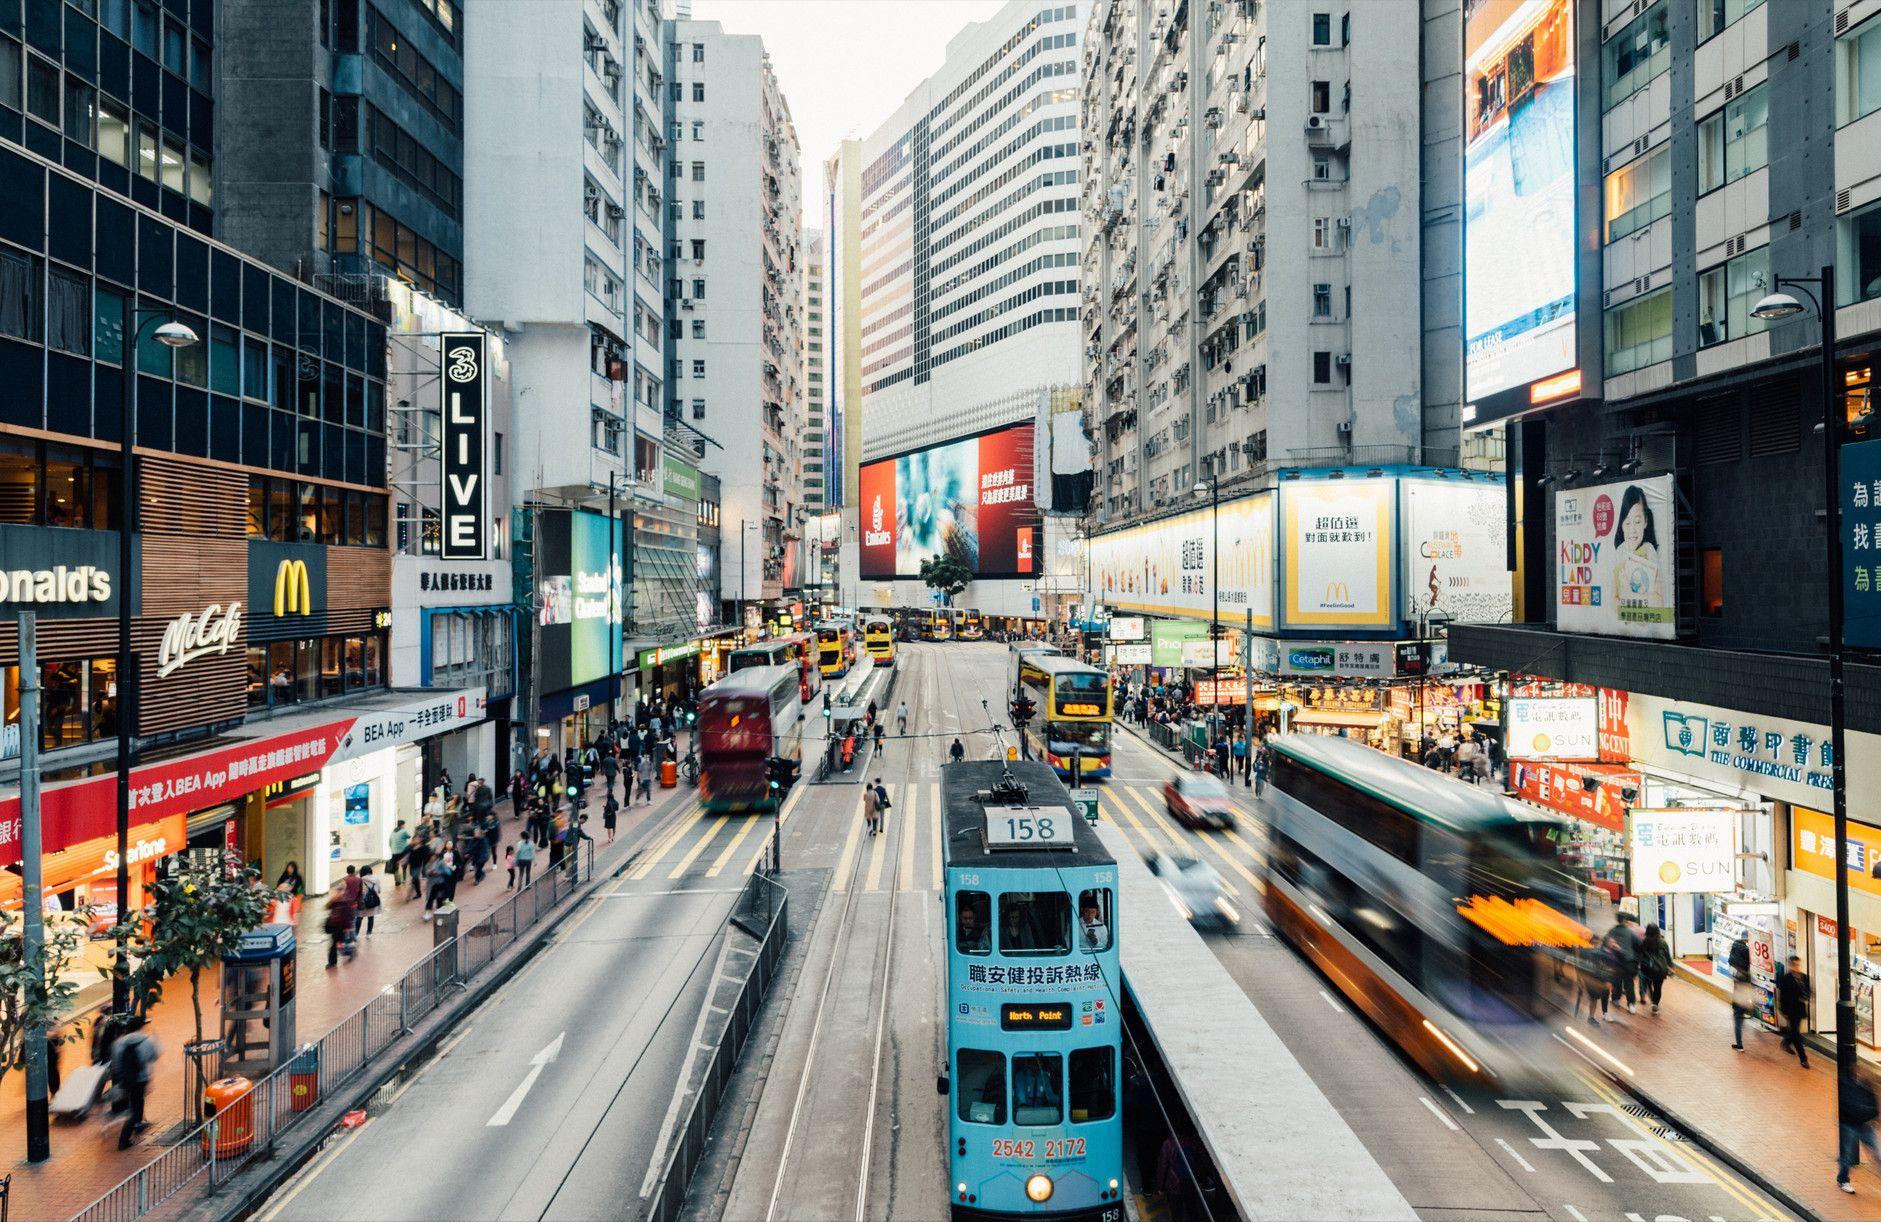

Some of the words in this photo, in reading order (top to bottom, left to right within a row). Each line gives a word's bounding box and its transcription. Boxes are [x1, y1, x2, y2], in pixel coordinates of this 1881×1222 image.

[449, 392, 478, 547] LIVE
[1315, 517, 1358, 530] 超值選
[1561, 566, 1593, 585] LAND
[158, 601, 241, 669] McCafé
[1292, 654, 1331, 666] Cetaphil
[364, 723, 384, 743] BEA
[386, 720, 404, 741] App
[1554, 734, 1591, 746] SUN
[1711, 751, 1730, 766] THE
[1733, 755, 1801, 782] COMMERCIAL
[203, 770, 226, 790] App
[1007, 818, 1055, 840] 158
[1094, 871, 1113, 883] 158
[1686, 861, 1730, 875] SUN
[960, 874, 980, 886] 158
[1753, 940, 1770, 960] 98
[969, 963, 1101, 985] 職安健投訴熱線
[960, 984, 997, 993] Occupational
[1001, 986, 1020, 994] Safety
[1058, 985, 1085, 993] Complaint
[1009, 1011, 1032, 1020] North
[1039, 1011, 1063, 1020] Point
[993, 1139, 1034, 1158] 2542
[1045, 1138, 1086, 1157] 2172
[1102, 1208, 1120, 1222] 158
